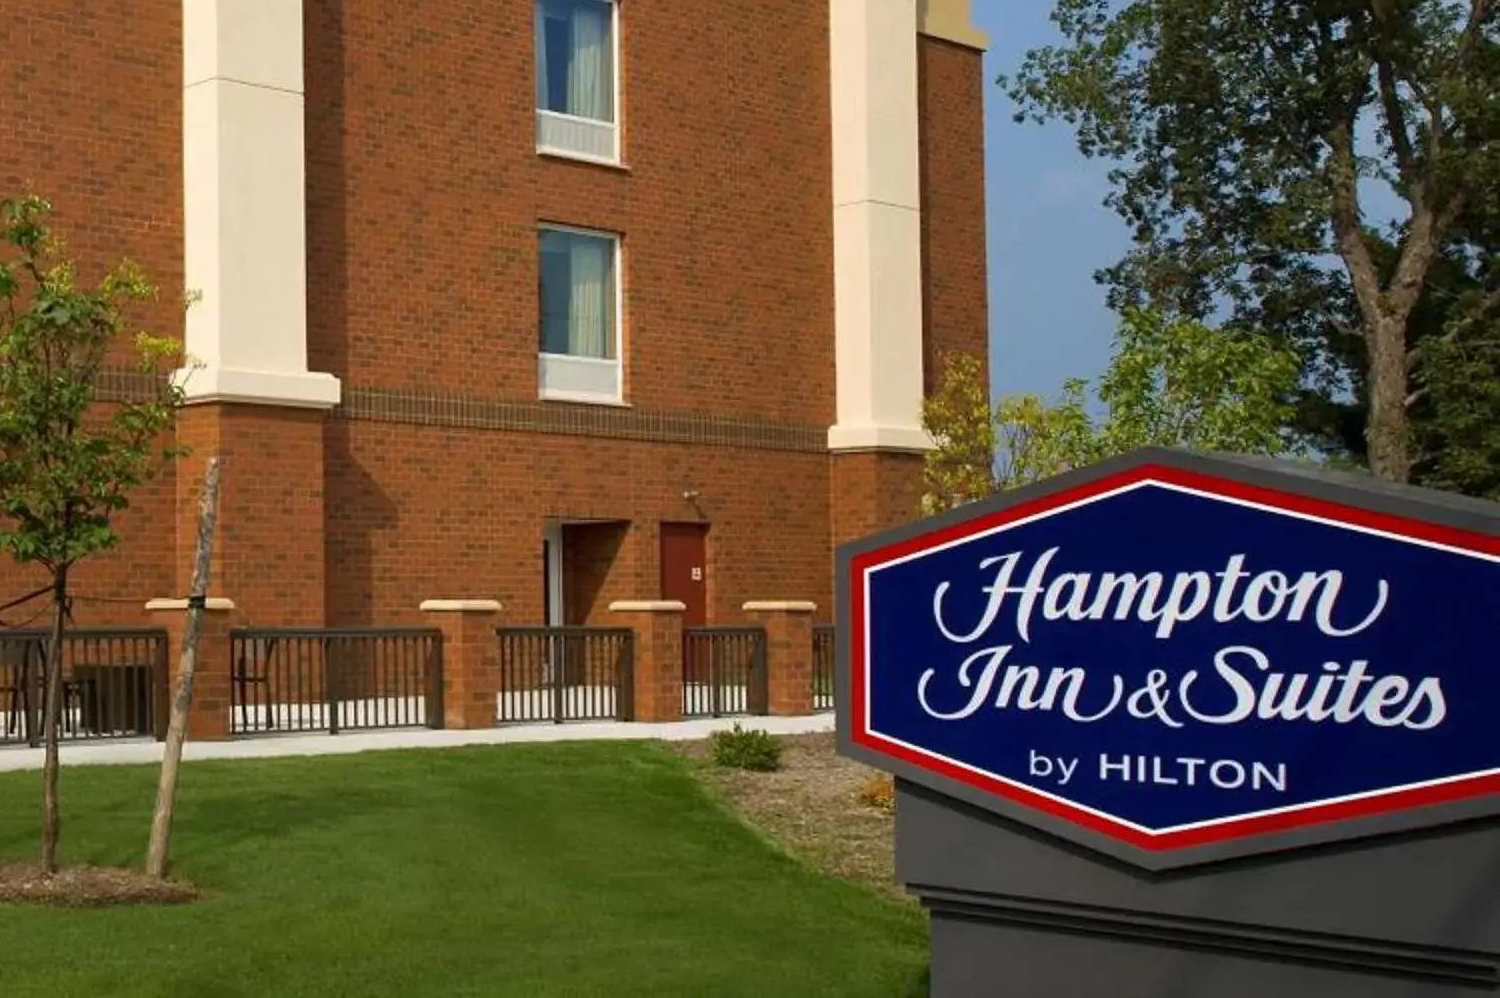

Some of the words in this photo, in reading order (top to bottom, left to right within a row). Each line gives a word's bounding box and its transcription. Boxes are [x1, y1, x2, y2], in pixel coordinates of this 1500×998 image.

[934, 546, 1388, 642] Hampton
[917, 645, 1124, 722] Inn
[1127, 669, 1184, 727] &
[1179, 645, 1447, 730] Suites
[1029, 749, 1079, 785] by
[1100, 754, 1286, 791] HILTON
